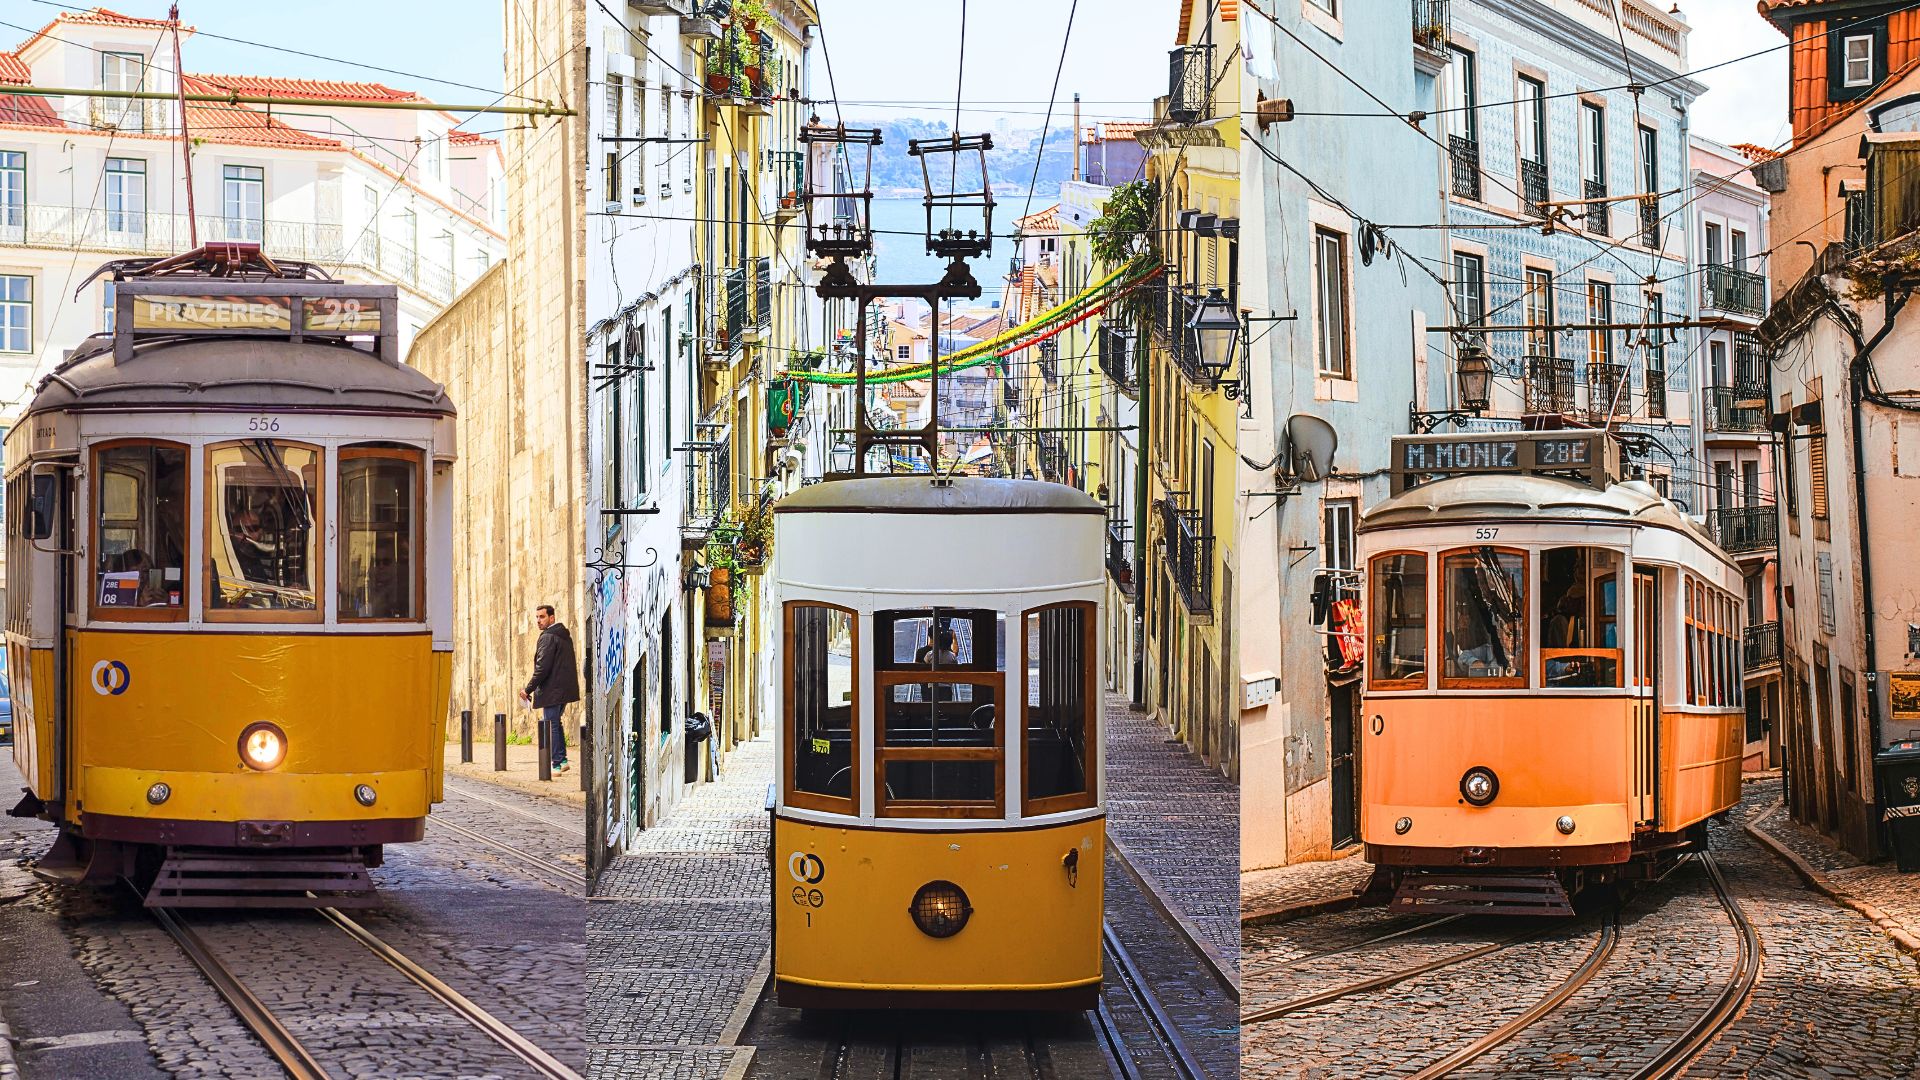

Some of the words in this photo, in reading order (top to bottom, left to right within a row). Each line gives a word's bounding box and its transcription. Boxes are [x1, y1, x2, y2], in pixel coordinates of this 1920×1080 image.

[149, 303, 280, 323] PRAZERES
[323, 299, 361, 329] 28
[249, 417, 279, 432] 556
[1543, 442, 1585, 463] 28E
[1476, 528, 1499, 540] 557
[105, 581, 118, 589] 28E
[104, 594, 117, 604] 08
[806, 912, 811, 928] 1
